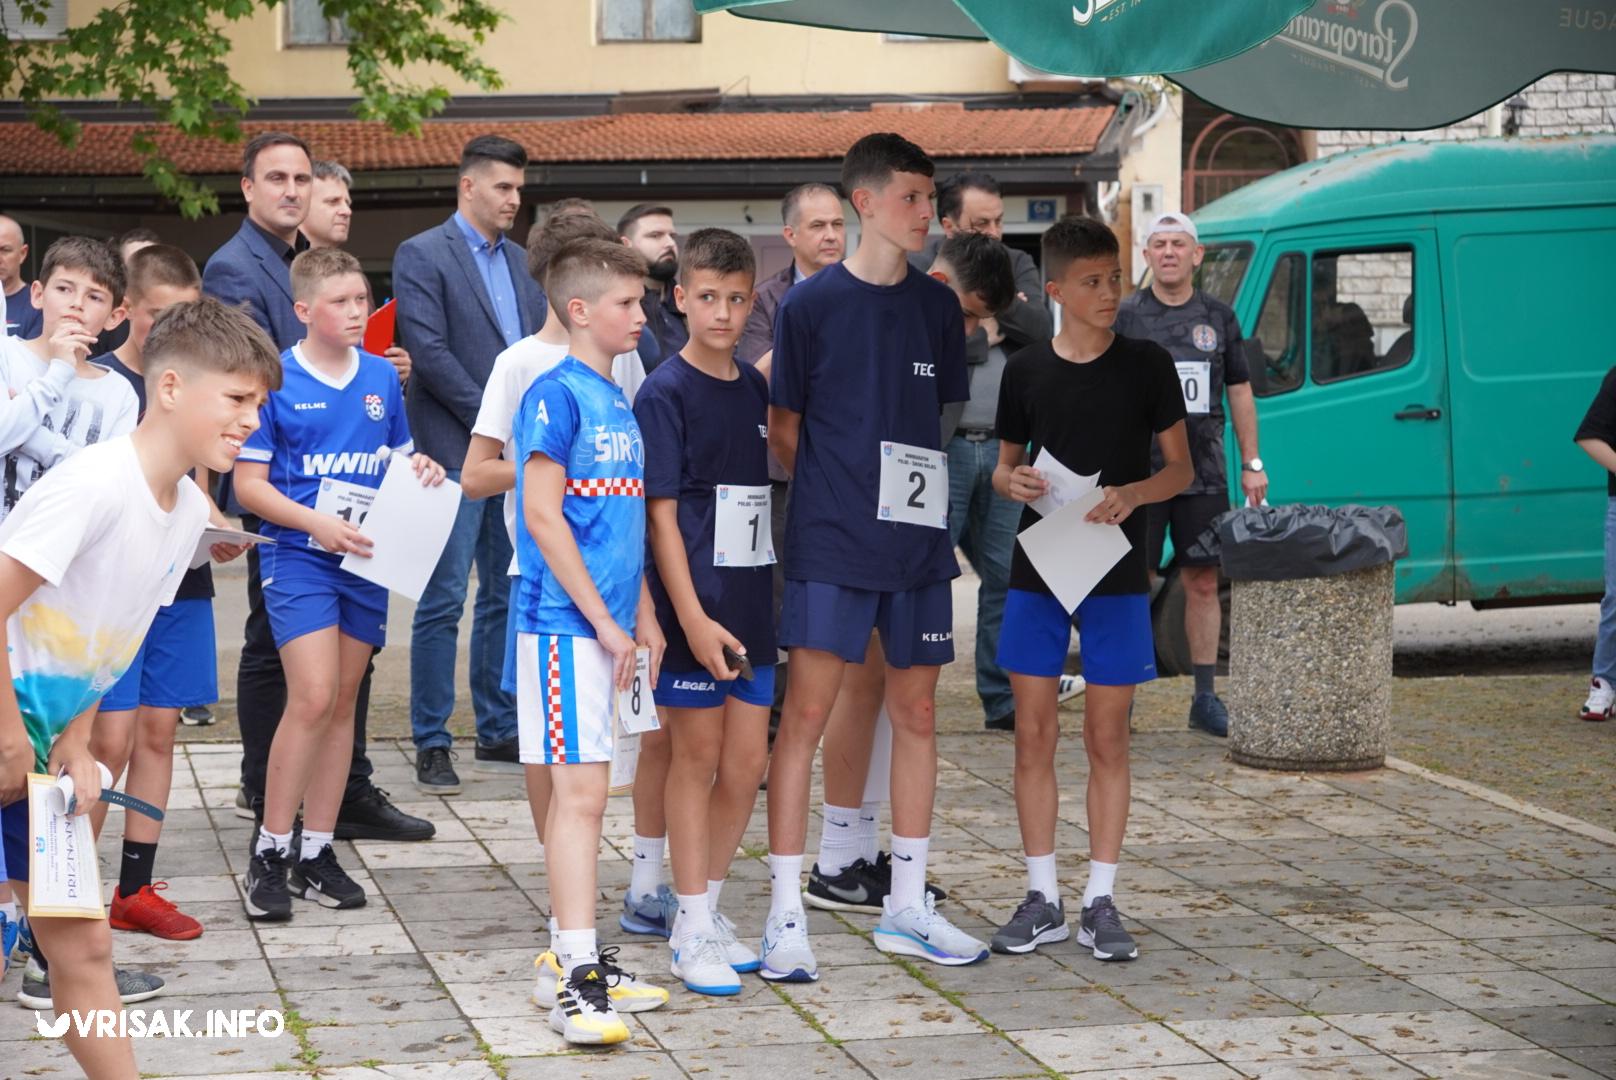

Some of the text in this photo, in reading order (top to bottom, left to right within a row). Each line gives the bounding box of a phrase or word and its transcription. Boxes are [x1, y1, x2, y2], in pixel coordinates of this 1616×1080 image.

[913, 362, 935, 377] TEC
[1180, 377, 1198, 402] 0
[295, 402, 327, 410] KELME
[907, 471, 926, 509] 2
[337, 507, 368, 527] 1
[749, 514, 759, 552] 1
[631, 676, 641, 715] 8
[672, 680, 716, 691] LEGEA
